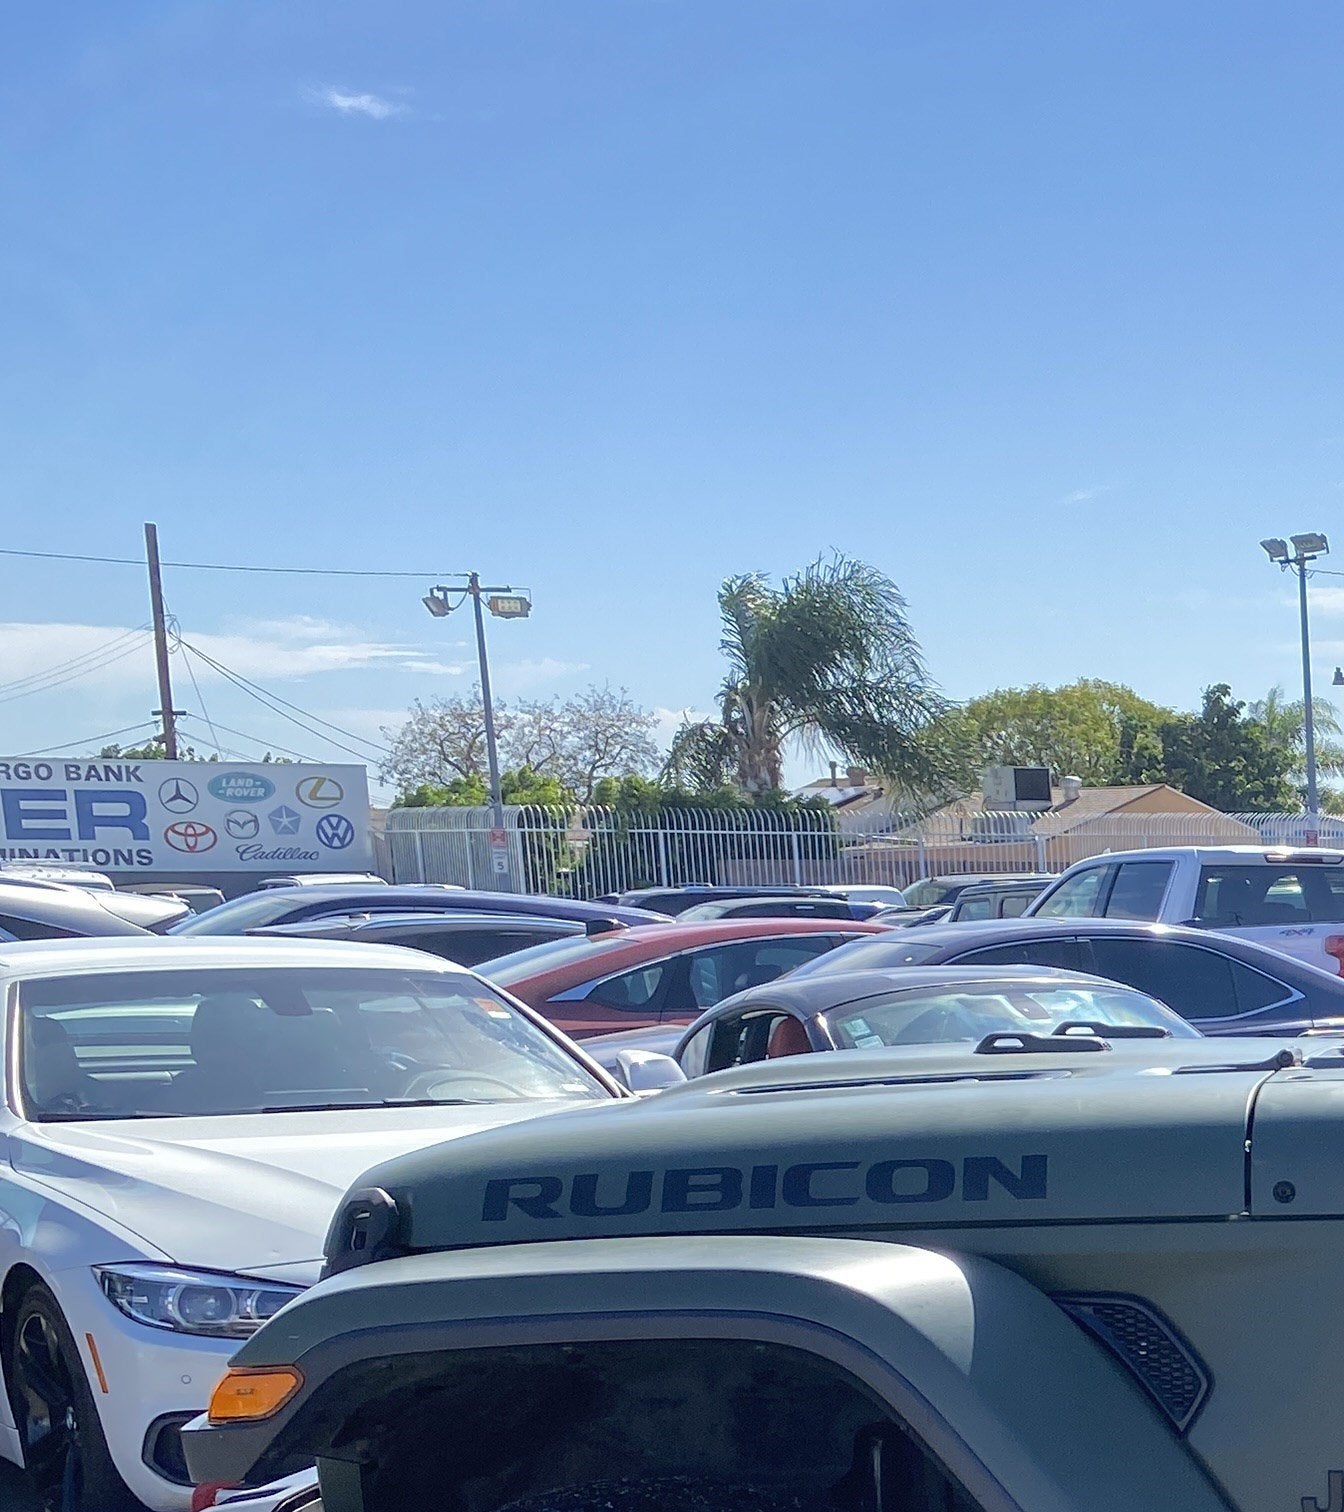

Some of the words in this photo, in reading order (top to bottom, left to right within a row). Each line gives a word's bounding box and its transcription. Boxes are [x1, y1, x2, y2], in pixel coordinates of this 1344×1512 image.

[64, 764, 144, 782] BANK
[0, 788, 150, 840] ER
[235, 843, 320, 862] Cadillac
[497, 861, 505, 870] 5
[481, 1154, 1049, 1222] RUBICON
